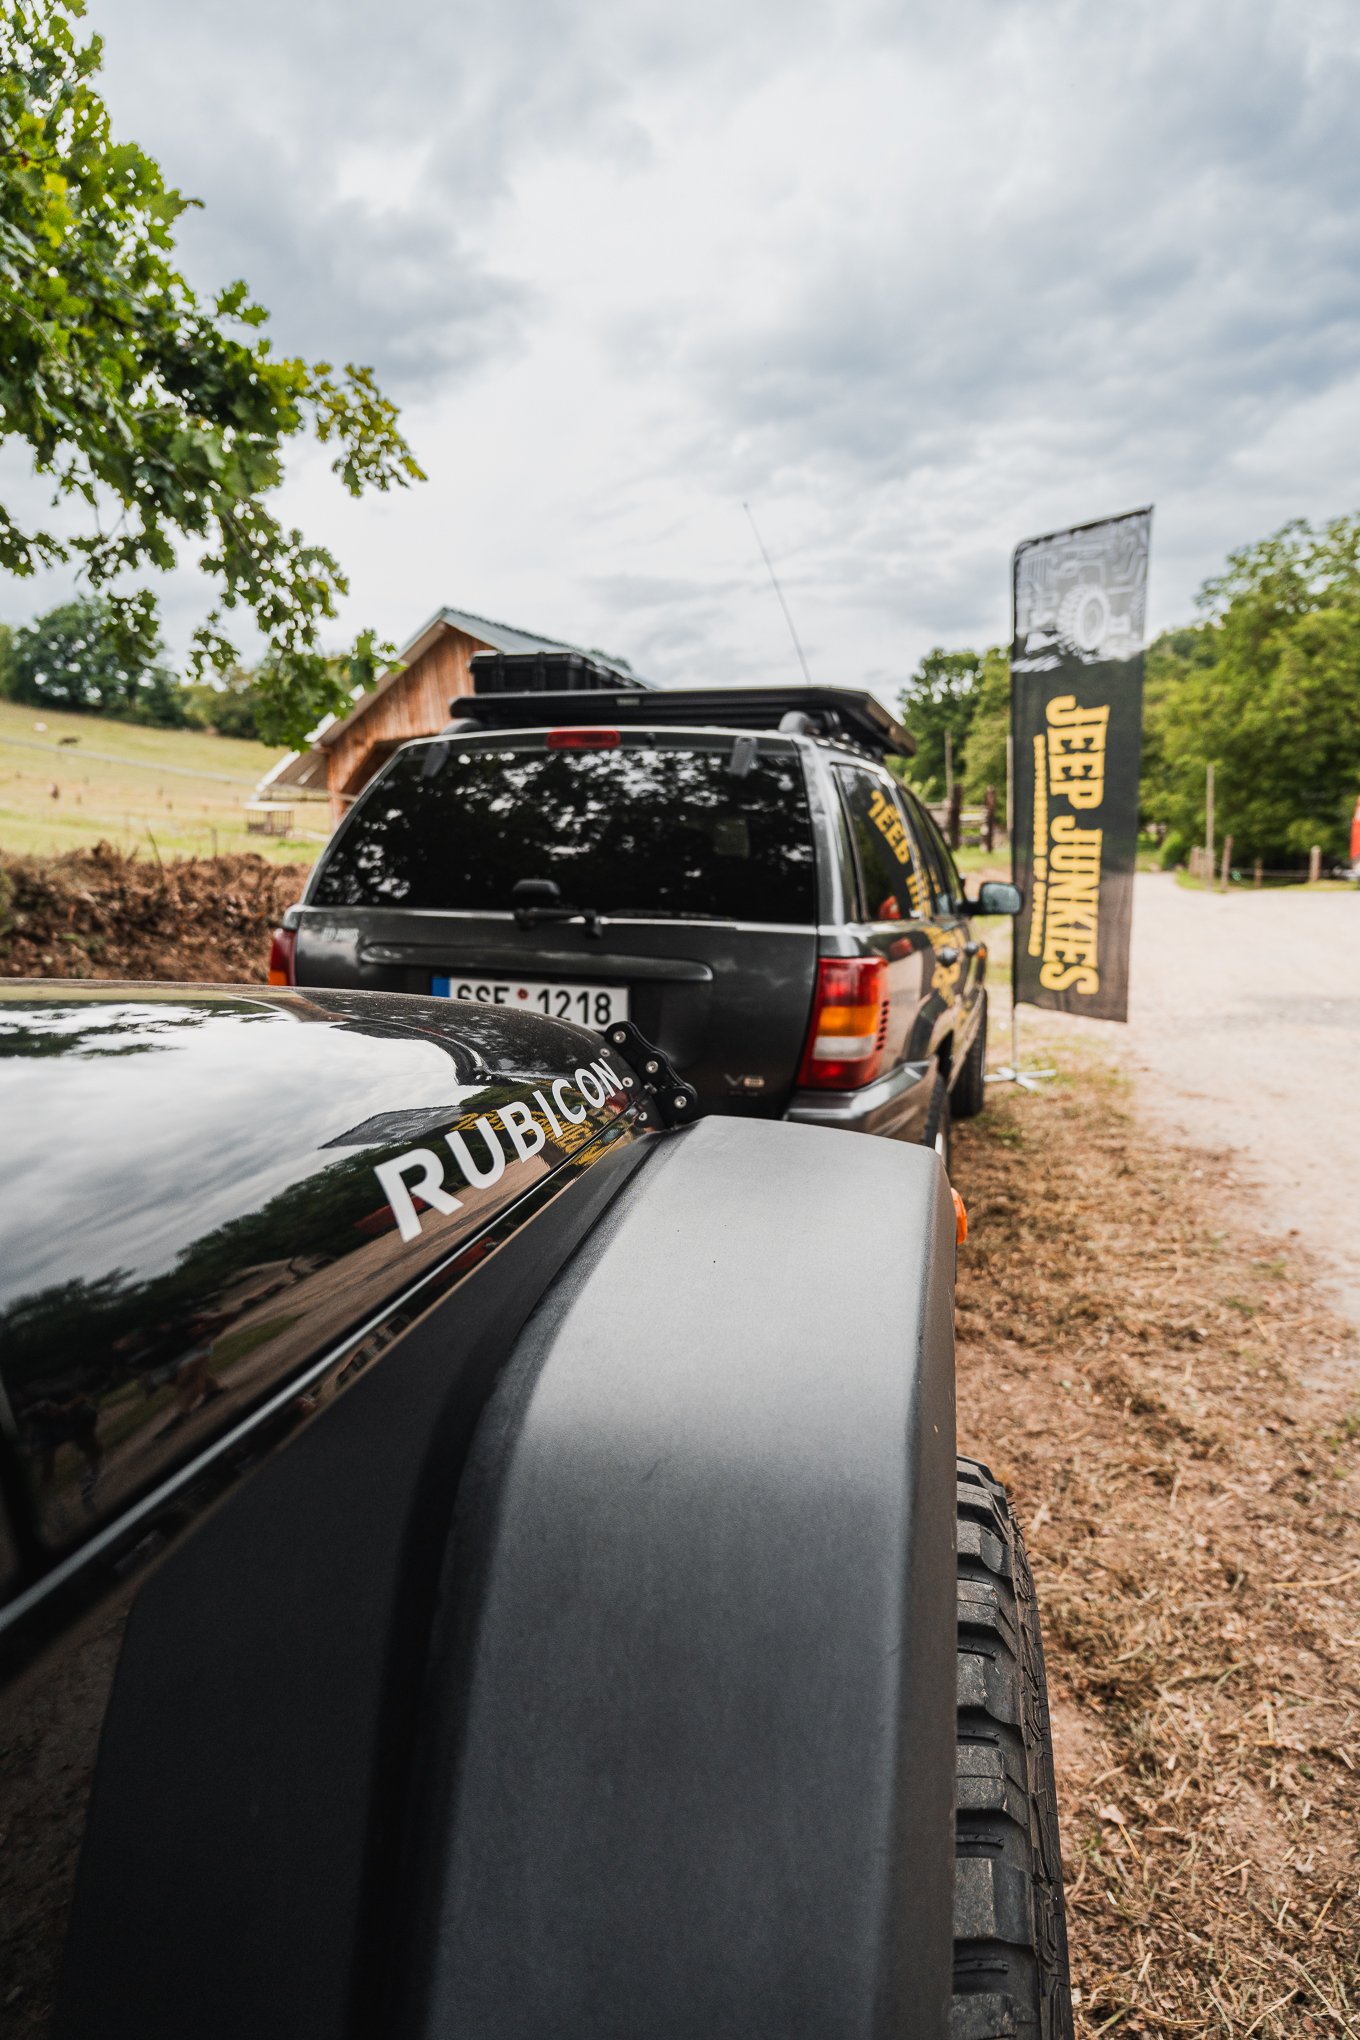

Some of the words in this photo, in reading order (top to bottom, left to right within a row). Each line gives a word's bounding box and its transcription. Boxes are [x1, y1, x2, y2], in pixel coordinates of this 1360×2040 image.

[1045, 694, 1110, 810] JEEP
[1039, 815, 1104, 995] JUNKIES
[537, 988, 612, 1026] 1218
[373, 1057, 624, 1243] RUBICON
